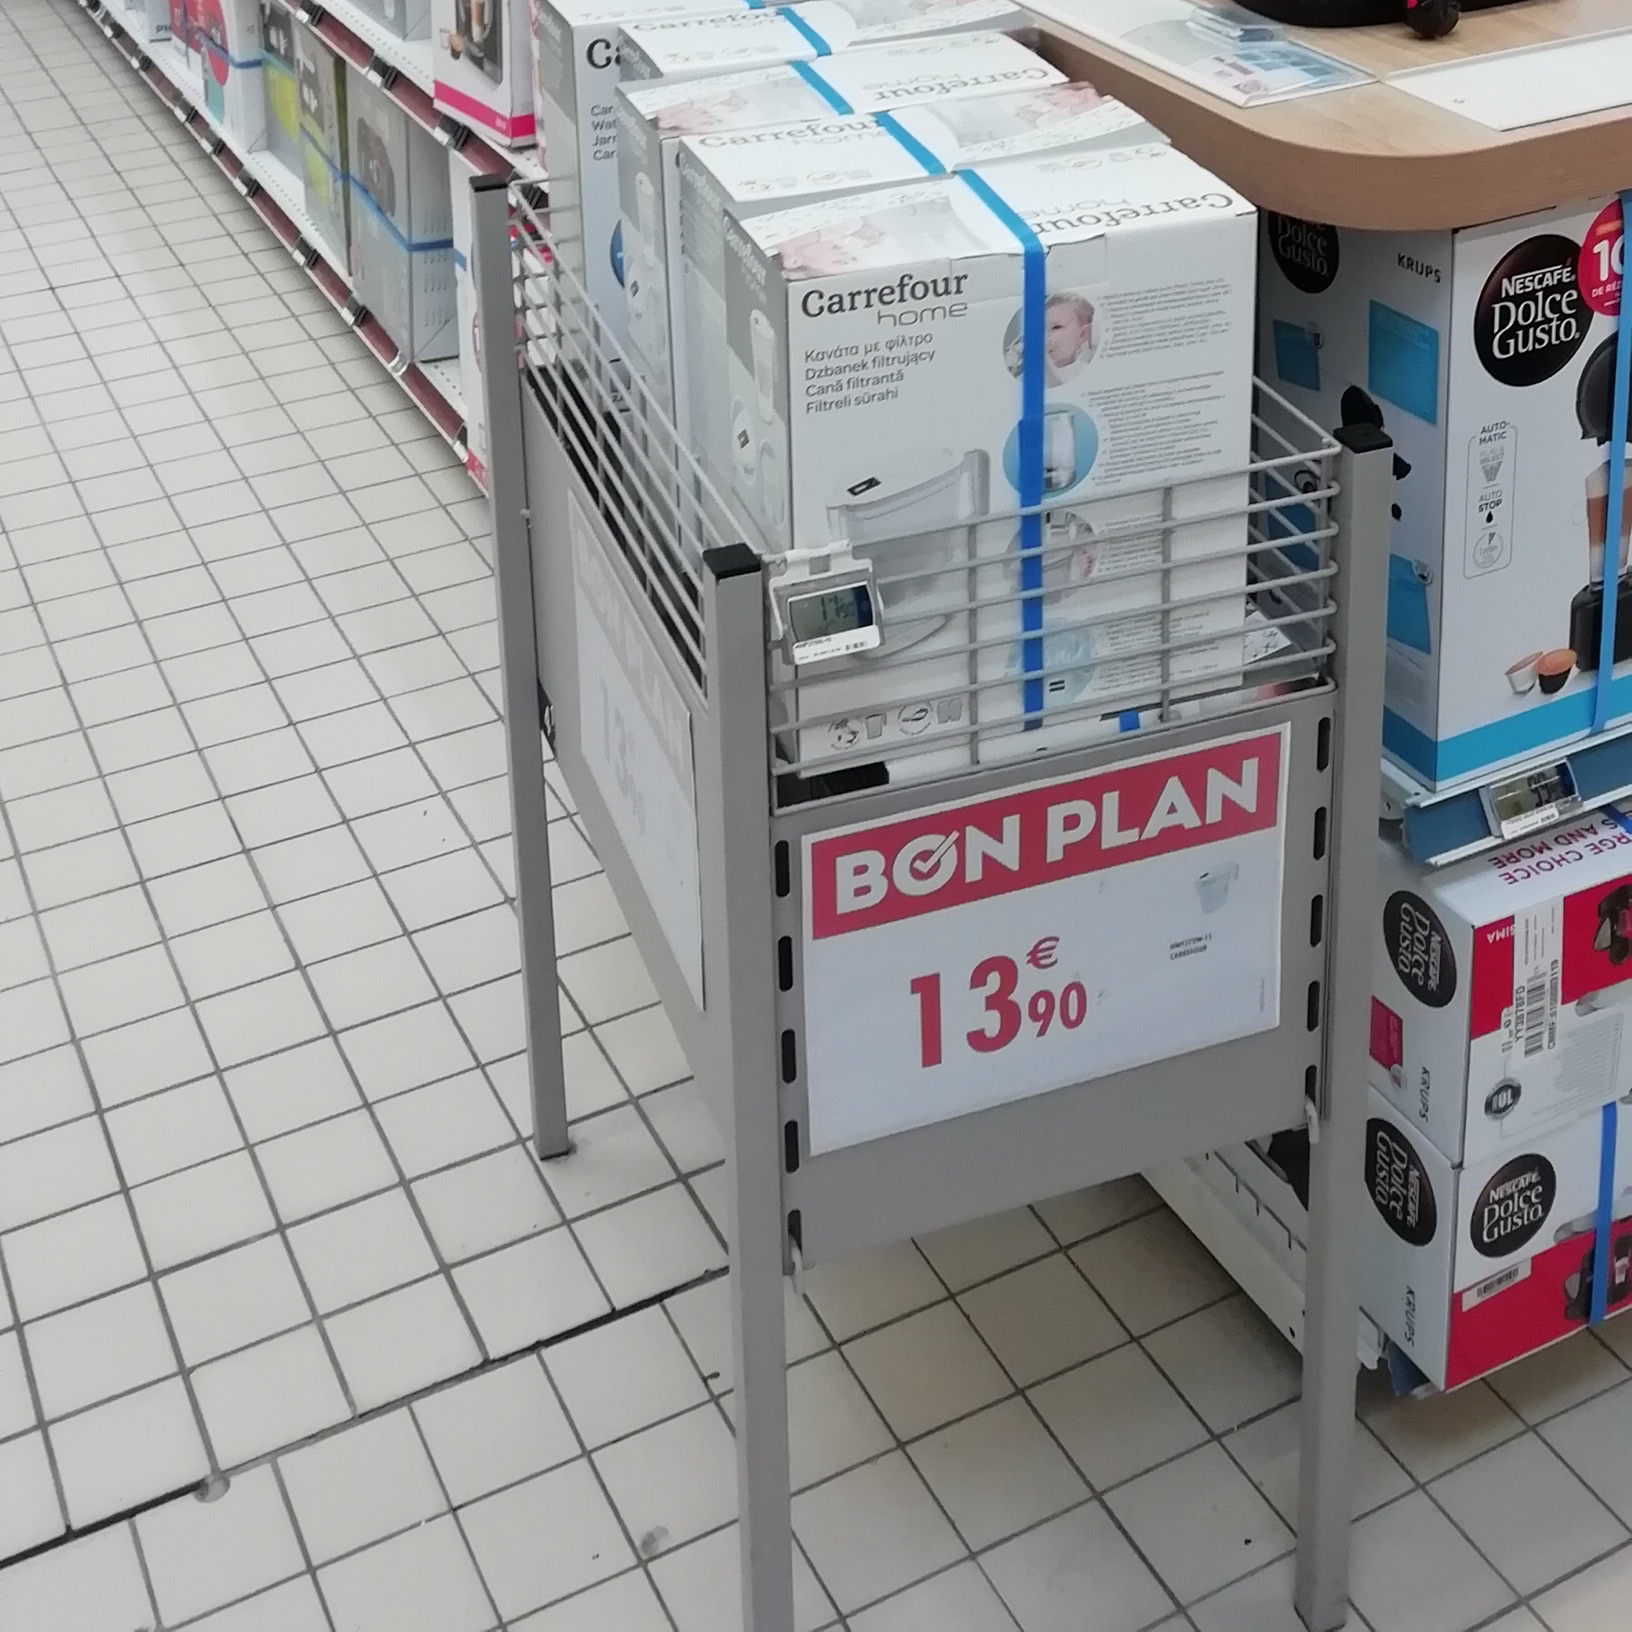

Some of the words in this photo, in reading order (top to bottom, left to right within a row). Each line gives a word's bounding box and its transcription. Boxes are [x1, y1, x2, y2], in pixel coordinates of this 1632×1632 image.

[632, 8, 782, 32] Carrefou
[874, 67, 1050, 102] Carrefour
[590, 105, 614, 116] Car
[1028, 192, 1235, 236] Carrefour
[1397, 252, 1442, 284] KRUPS
[801, 273, 969, 320] Carrefour
[1491, 288, 1579, 336] Dolce
[876, 301, 969, 328] home
[1491, 314, 1580, 360] Gusto
[805, 358, 869, 382] Dzbanek
[871, 348, 936, 370] filtrujący
[805, 379, 843, 399] Cană
[847, 370, 905, 390] filtrantă
[805, 391, 852, 415] Filtreli
[854, 386, 900, 407] sürahi
[1479, 431, 1507, 446] MATIC
[1478, 489, 1503, 503] AUTO
[1478, 498, 1503, 513] STOP
[836, 814, 1020, 915] BON
[1046, 757, 1260, 863] PLAN
[1553, 823, 1599, 846] AND
[1584, 832, 1632, 856] RGE
[1487, 840, 1553, 870] MORE
[1498, 849, 1584, 885] CHOICE
[1397, 901, 1416, 974] Gusto
[1410, 910, 1430, 986] Dolce
[1420, 1065, 1431, 1125] KRUPS
[1374, 1130, 1392, 1206] Gusto
[1388, 1140, 1408, 1221] Dolce
[1482, 1205, 1544, 1245] Gusto
[1483, 1182, 1544, 1233] Dolce
[1404, 1283, 1416, 1348] KRUPS
